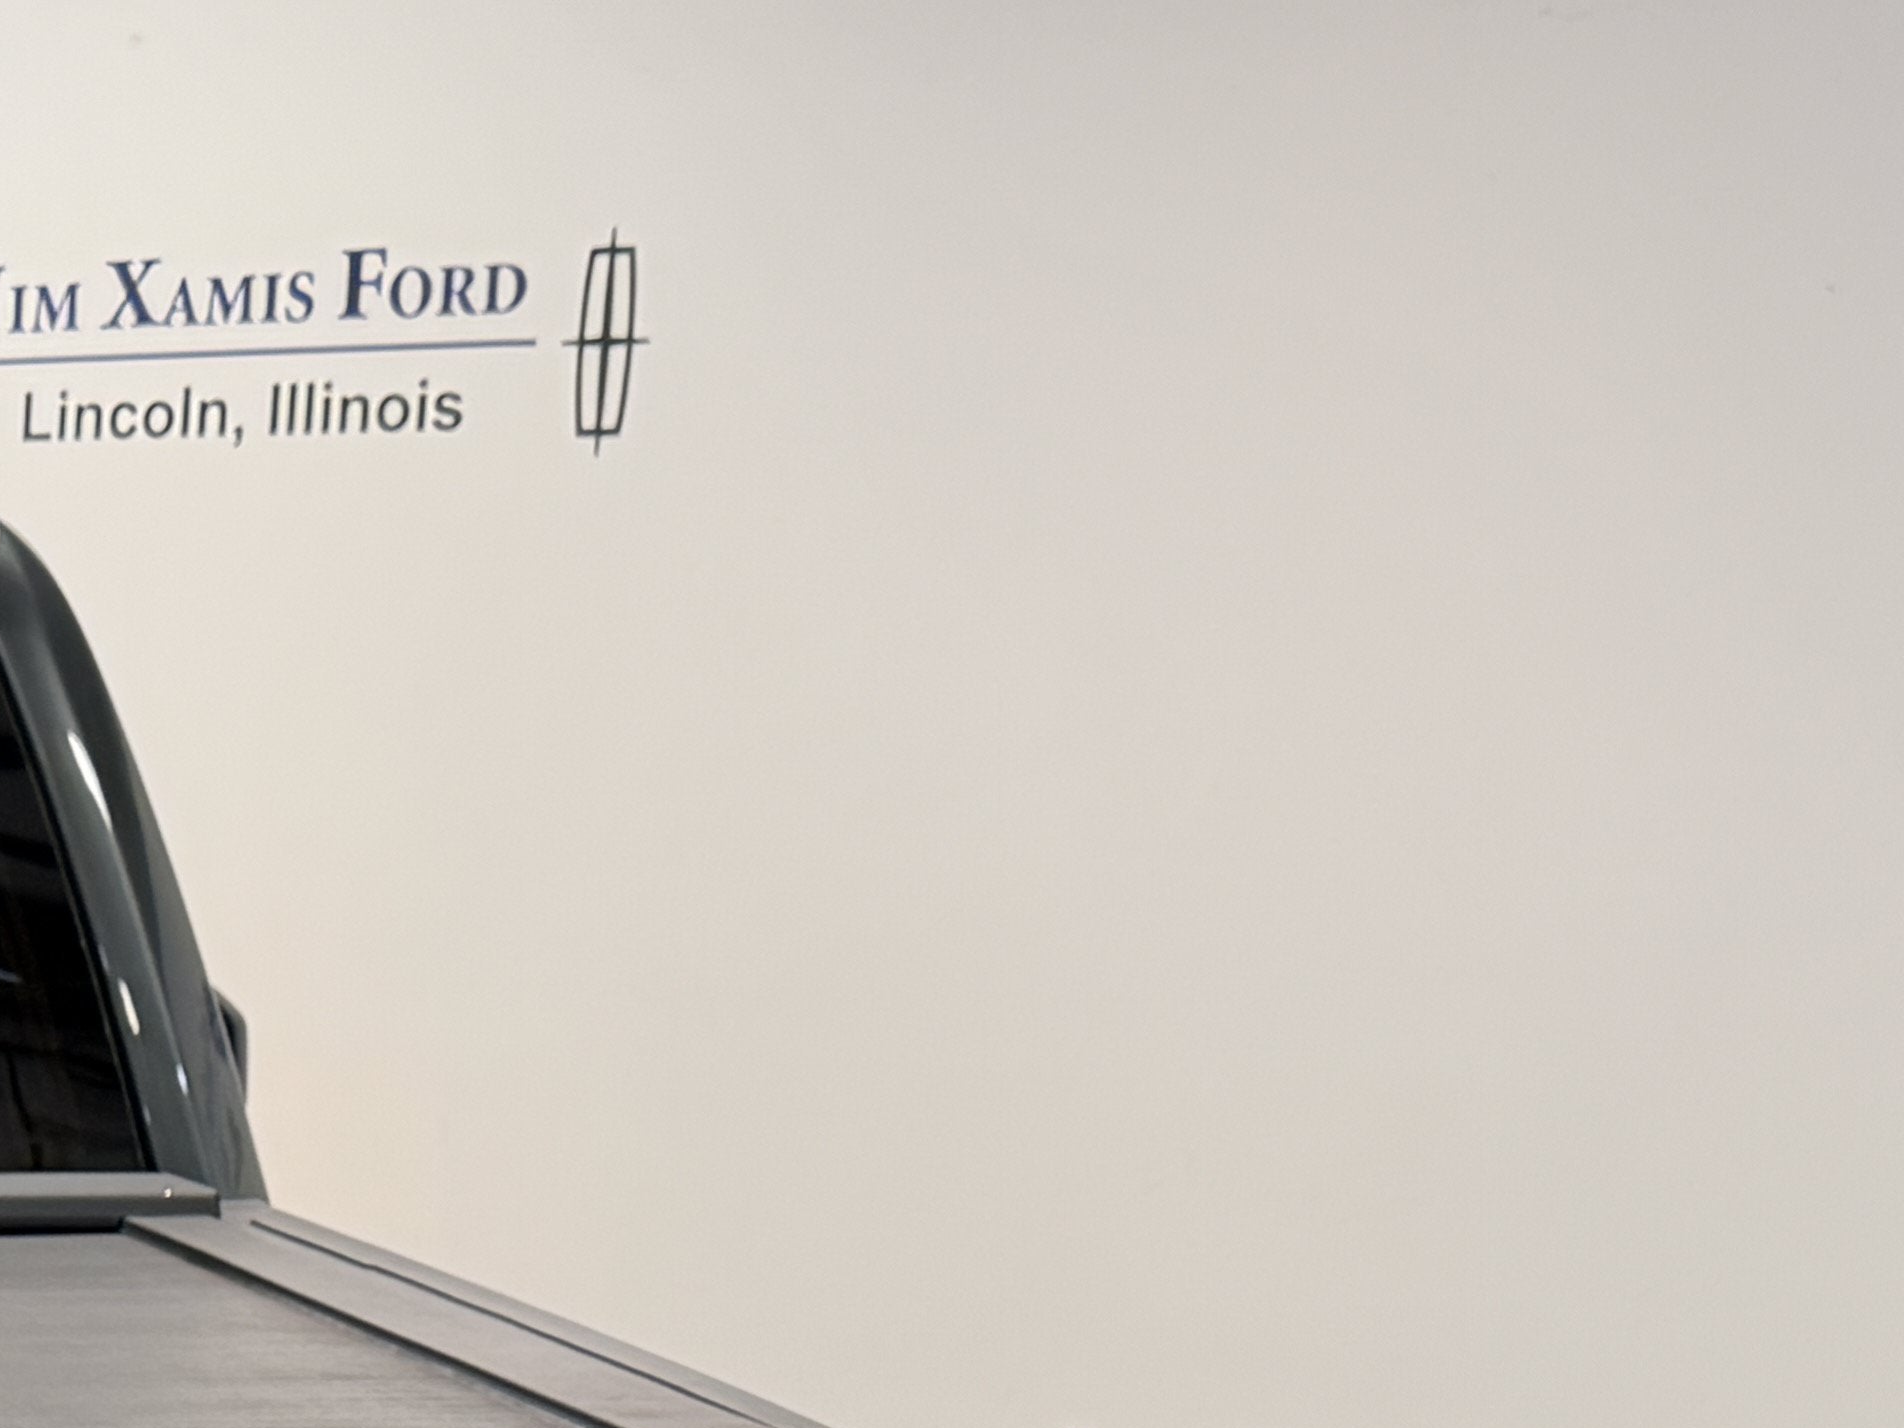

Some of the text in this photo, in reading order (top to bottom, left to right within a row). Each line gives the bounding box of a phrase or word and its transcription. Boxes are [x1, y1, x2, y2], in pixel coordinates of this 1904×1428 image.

[99, 256, 317, 332] XAMIS
[337, 246, 530, 321] FORD
[20, 378, 465, 449] Lincoln, Illinois
